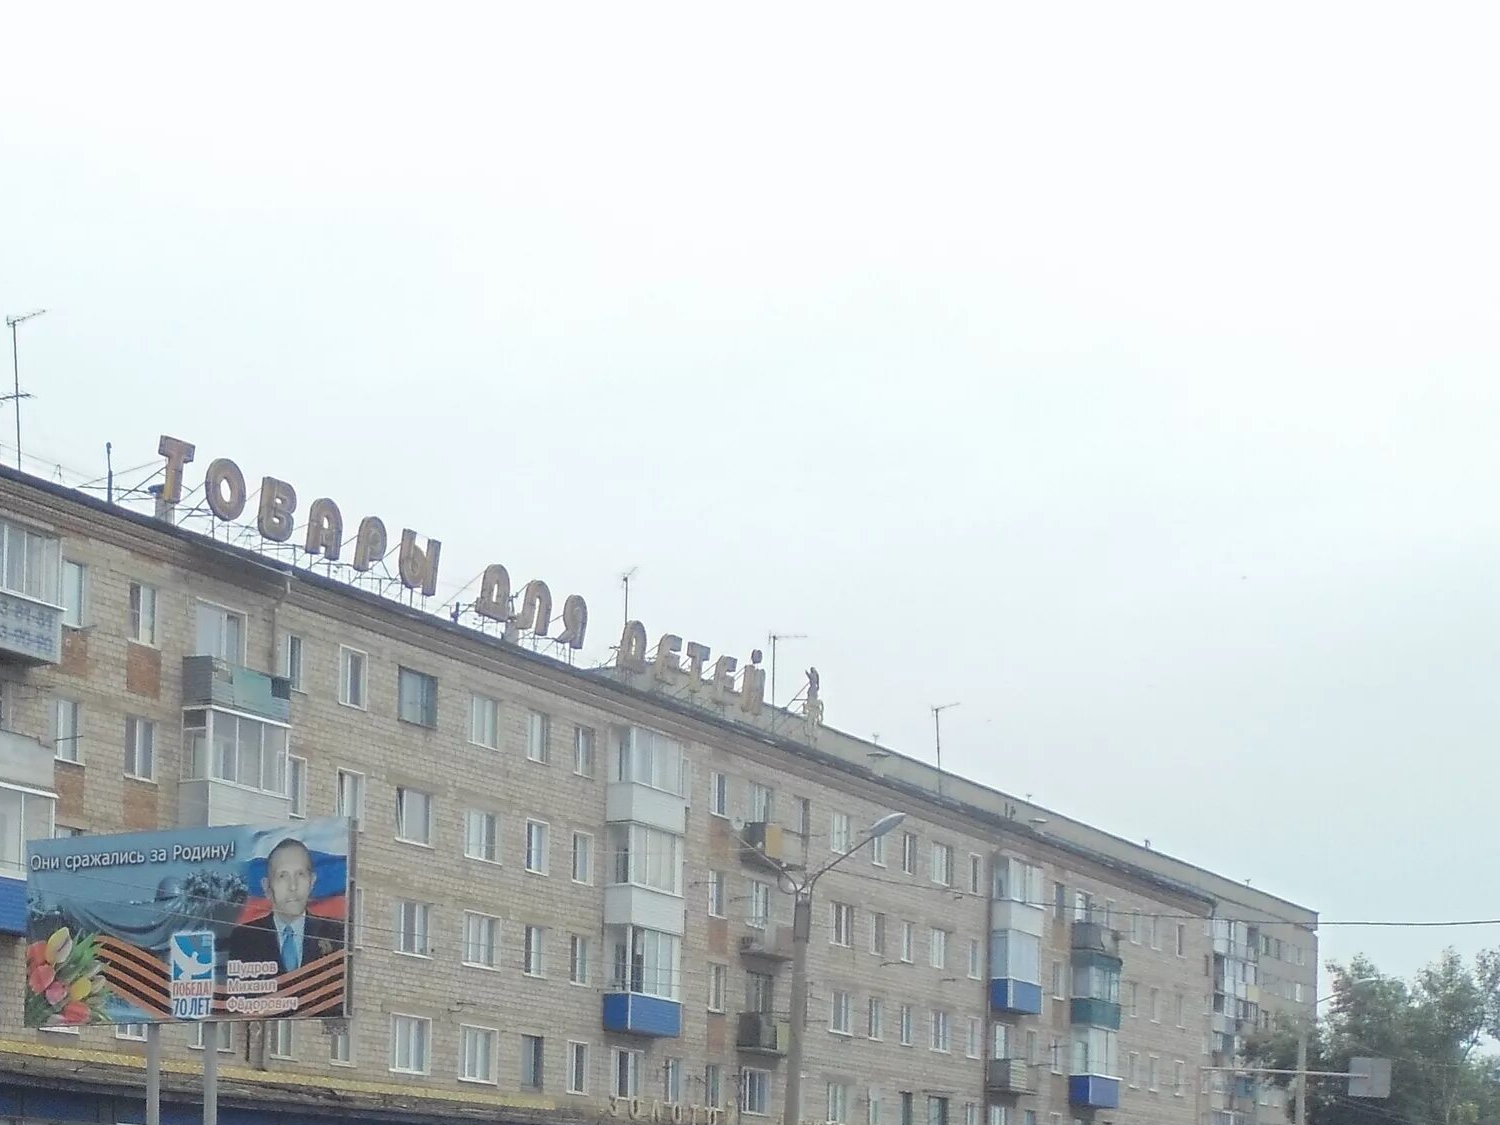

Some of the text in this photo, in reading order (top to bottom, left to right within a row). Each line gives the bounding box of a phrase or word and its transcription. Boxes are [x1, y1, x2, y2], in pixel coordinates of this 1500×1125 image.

[158, 435, 766, 715] ТОВАРЫ ДЛЯ ДЕТЕЙ
[30, 841, 236, 872] Они сражались за Родину!
[173, 981, 213, 996] ПОБЕДА!
[227, 979, 277, 993] Михаил
[174, 998, 212, 1016] 70 ЛЕТ
